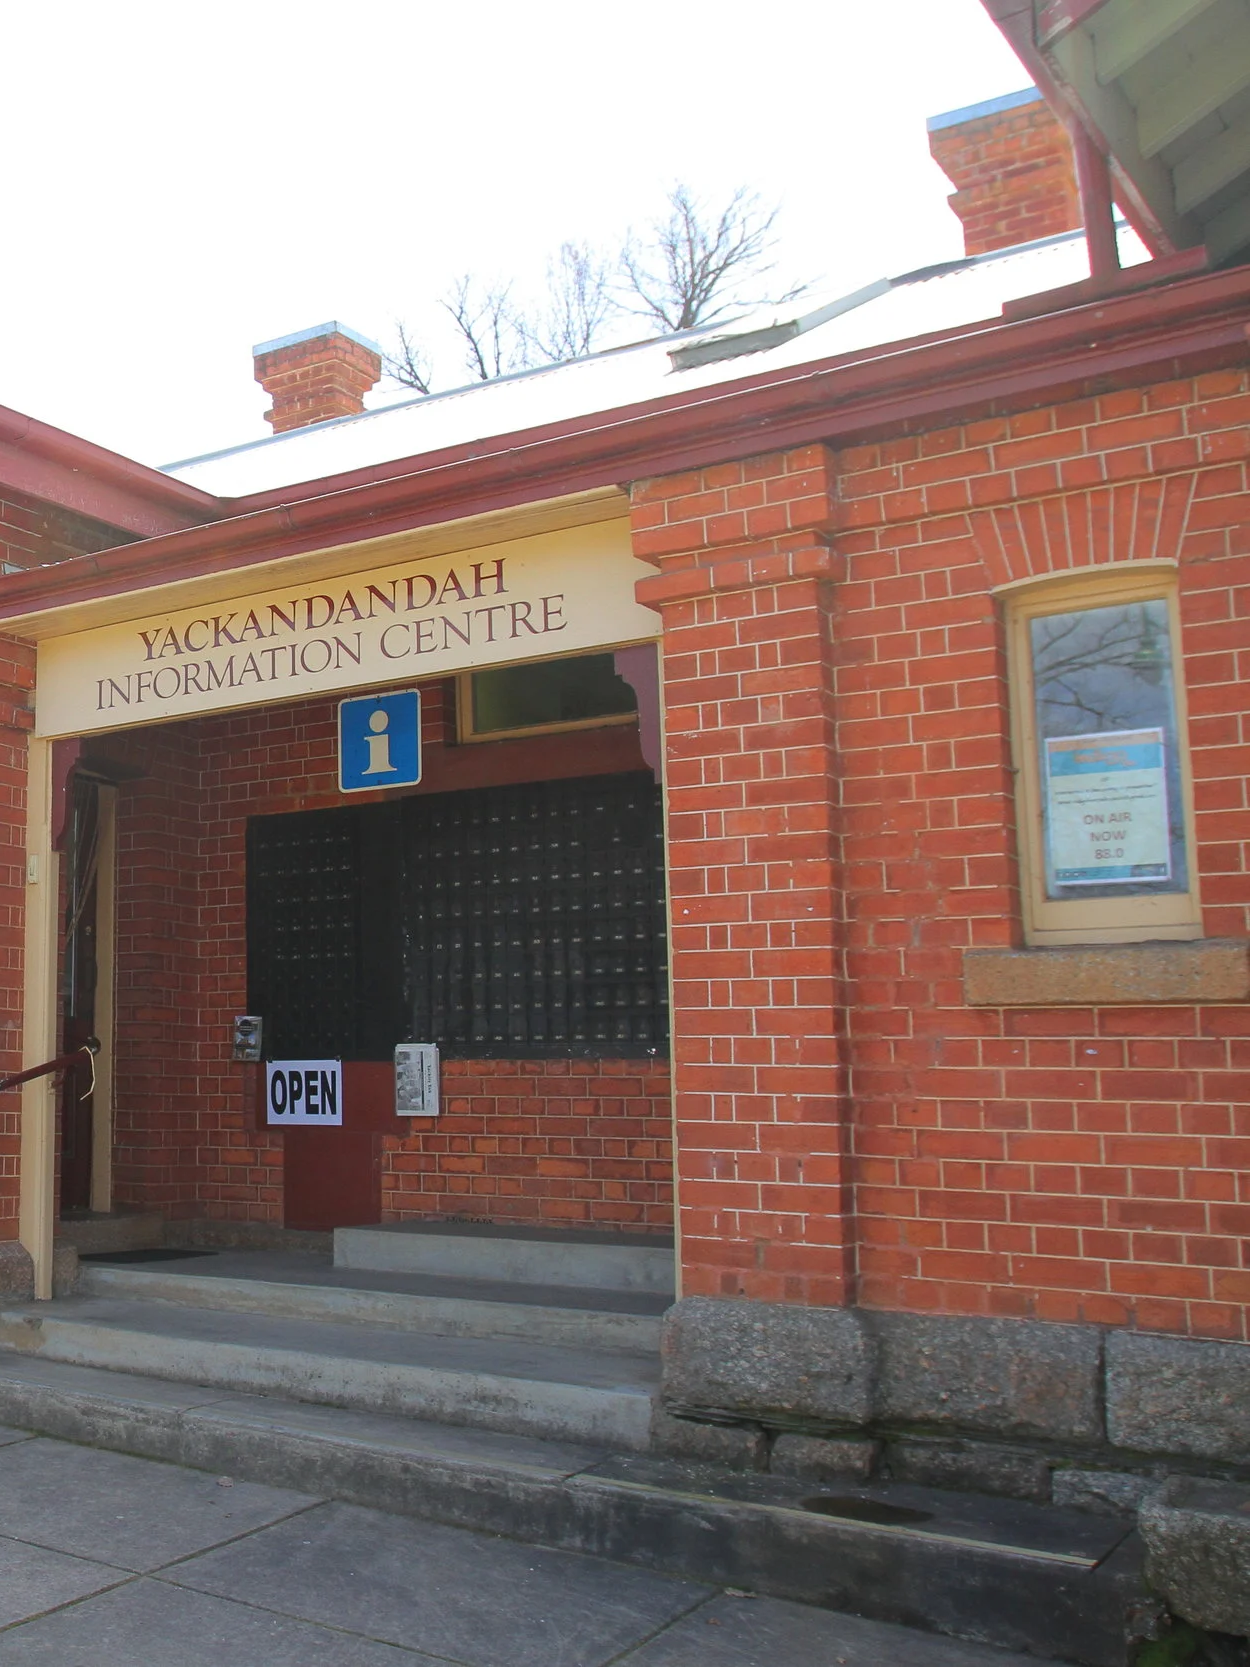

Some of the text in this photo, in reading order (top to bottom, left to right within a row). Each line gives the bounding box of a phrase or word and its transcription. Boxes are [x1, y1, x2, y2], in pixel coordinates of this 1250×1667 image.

[137, 558, 509, 661] YACKANDANDAH
[96, 594, 568, 710] INFORMATION CENTRE
[1083, 811, 1132, 825] ON AIR
[1089, 830, 1127, 842] NOW
[271, 1070, 337, 1115] OPEN
